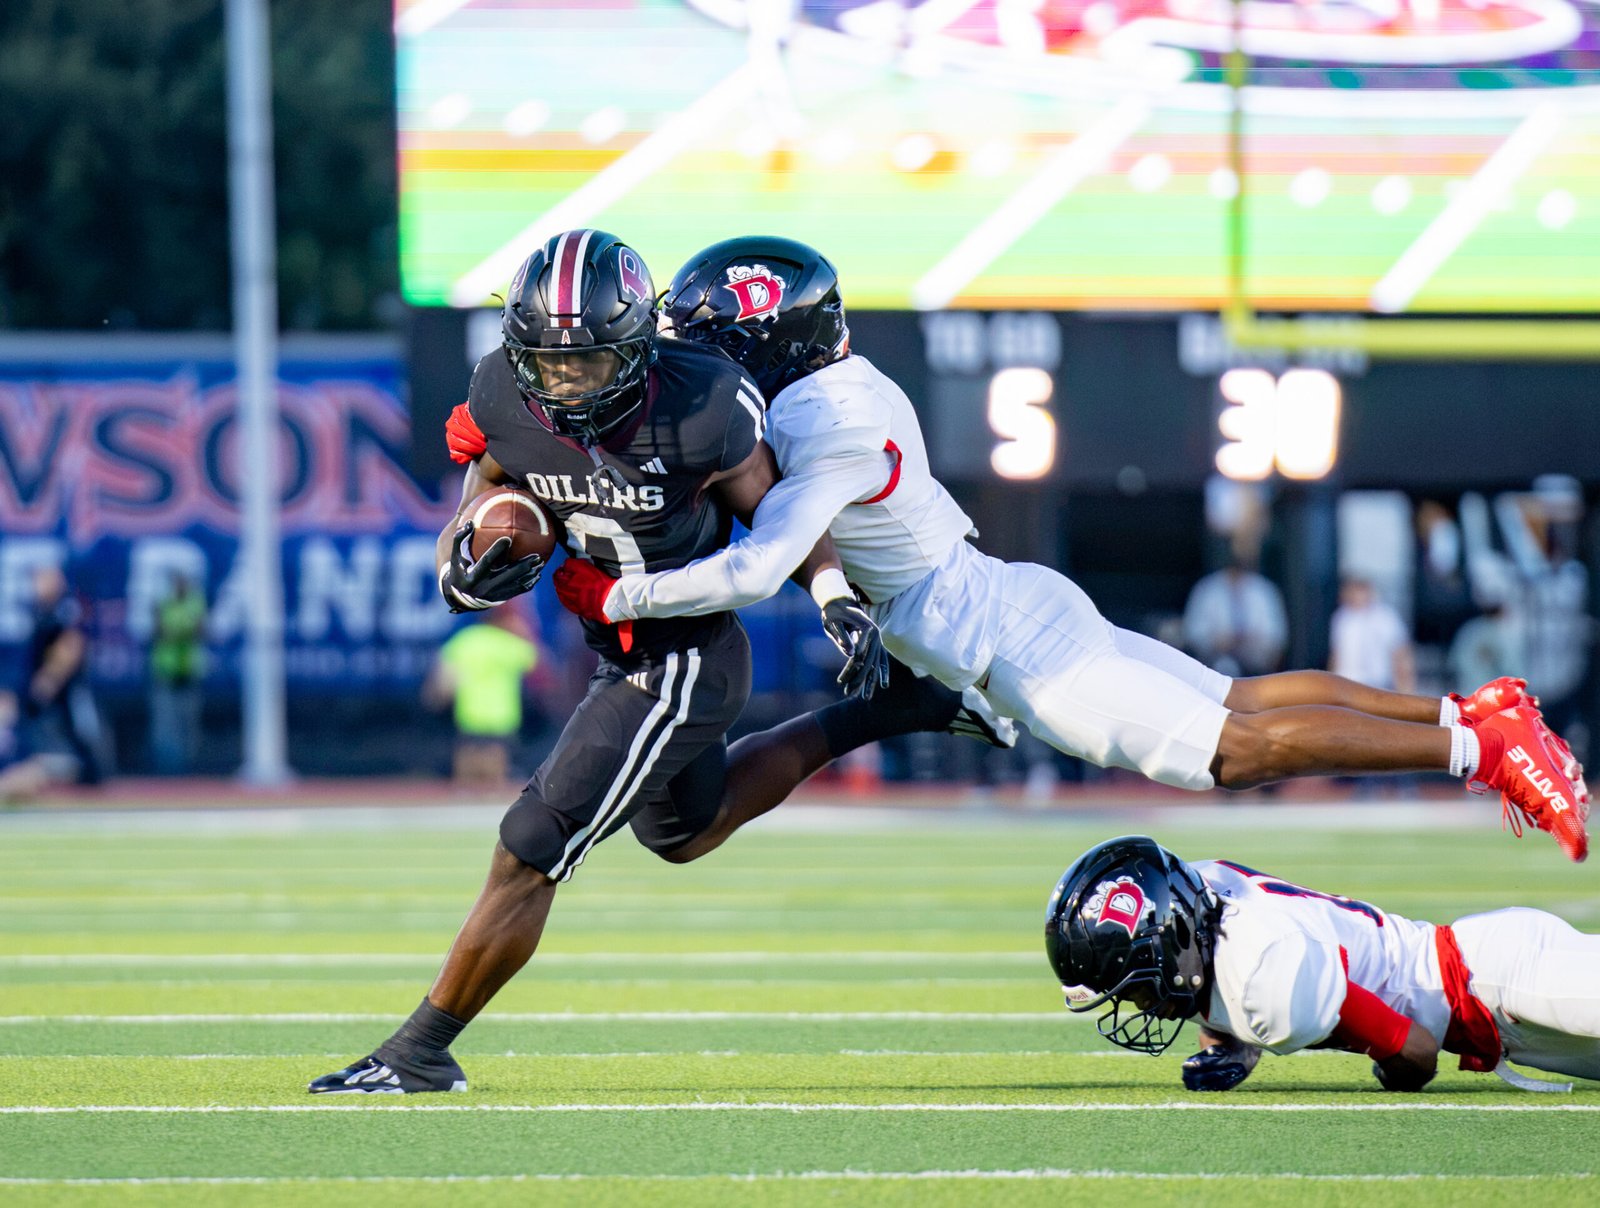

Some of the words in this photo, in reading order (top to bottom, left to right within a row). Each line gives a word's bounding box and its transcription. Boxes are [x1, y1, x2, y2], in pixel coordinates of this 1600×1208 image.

[618, 247, 648, 304] P
[723, 274, 783, 322] D
[989, 366, 1056, 479] 5
[526, 472, 665, 511] OILERS
[1506, 745, 1569, 814] BATTLE
